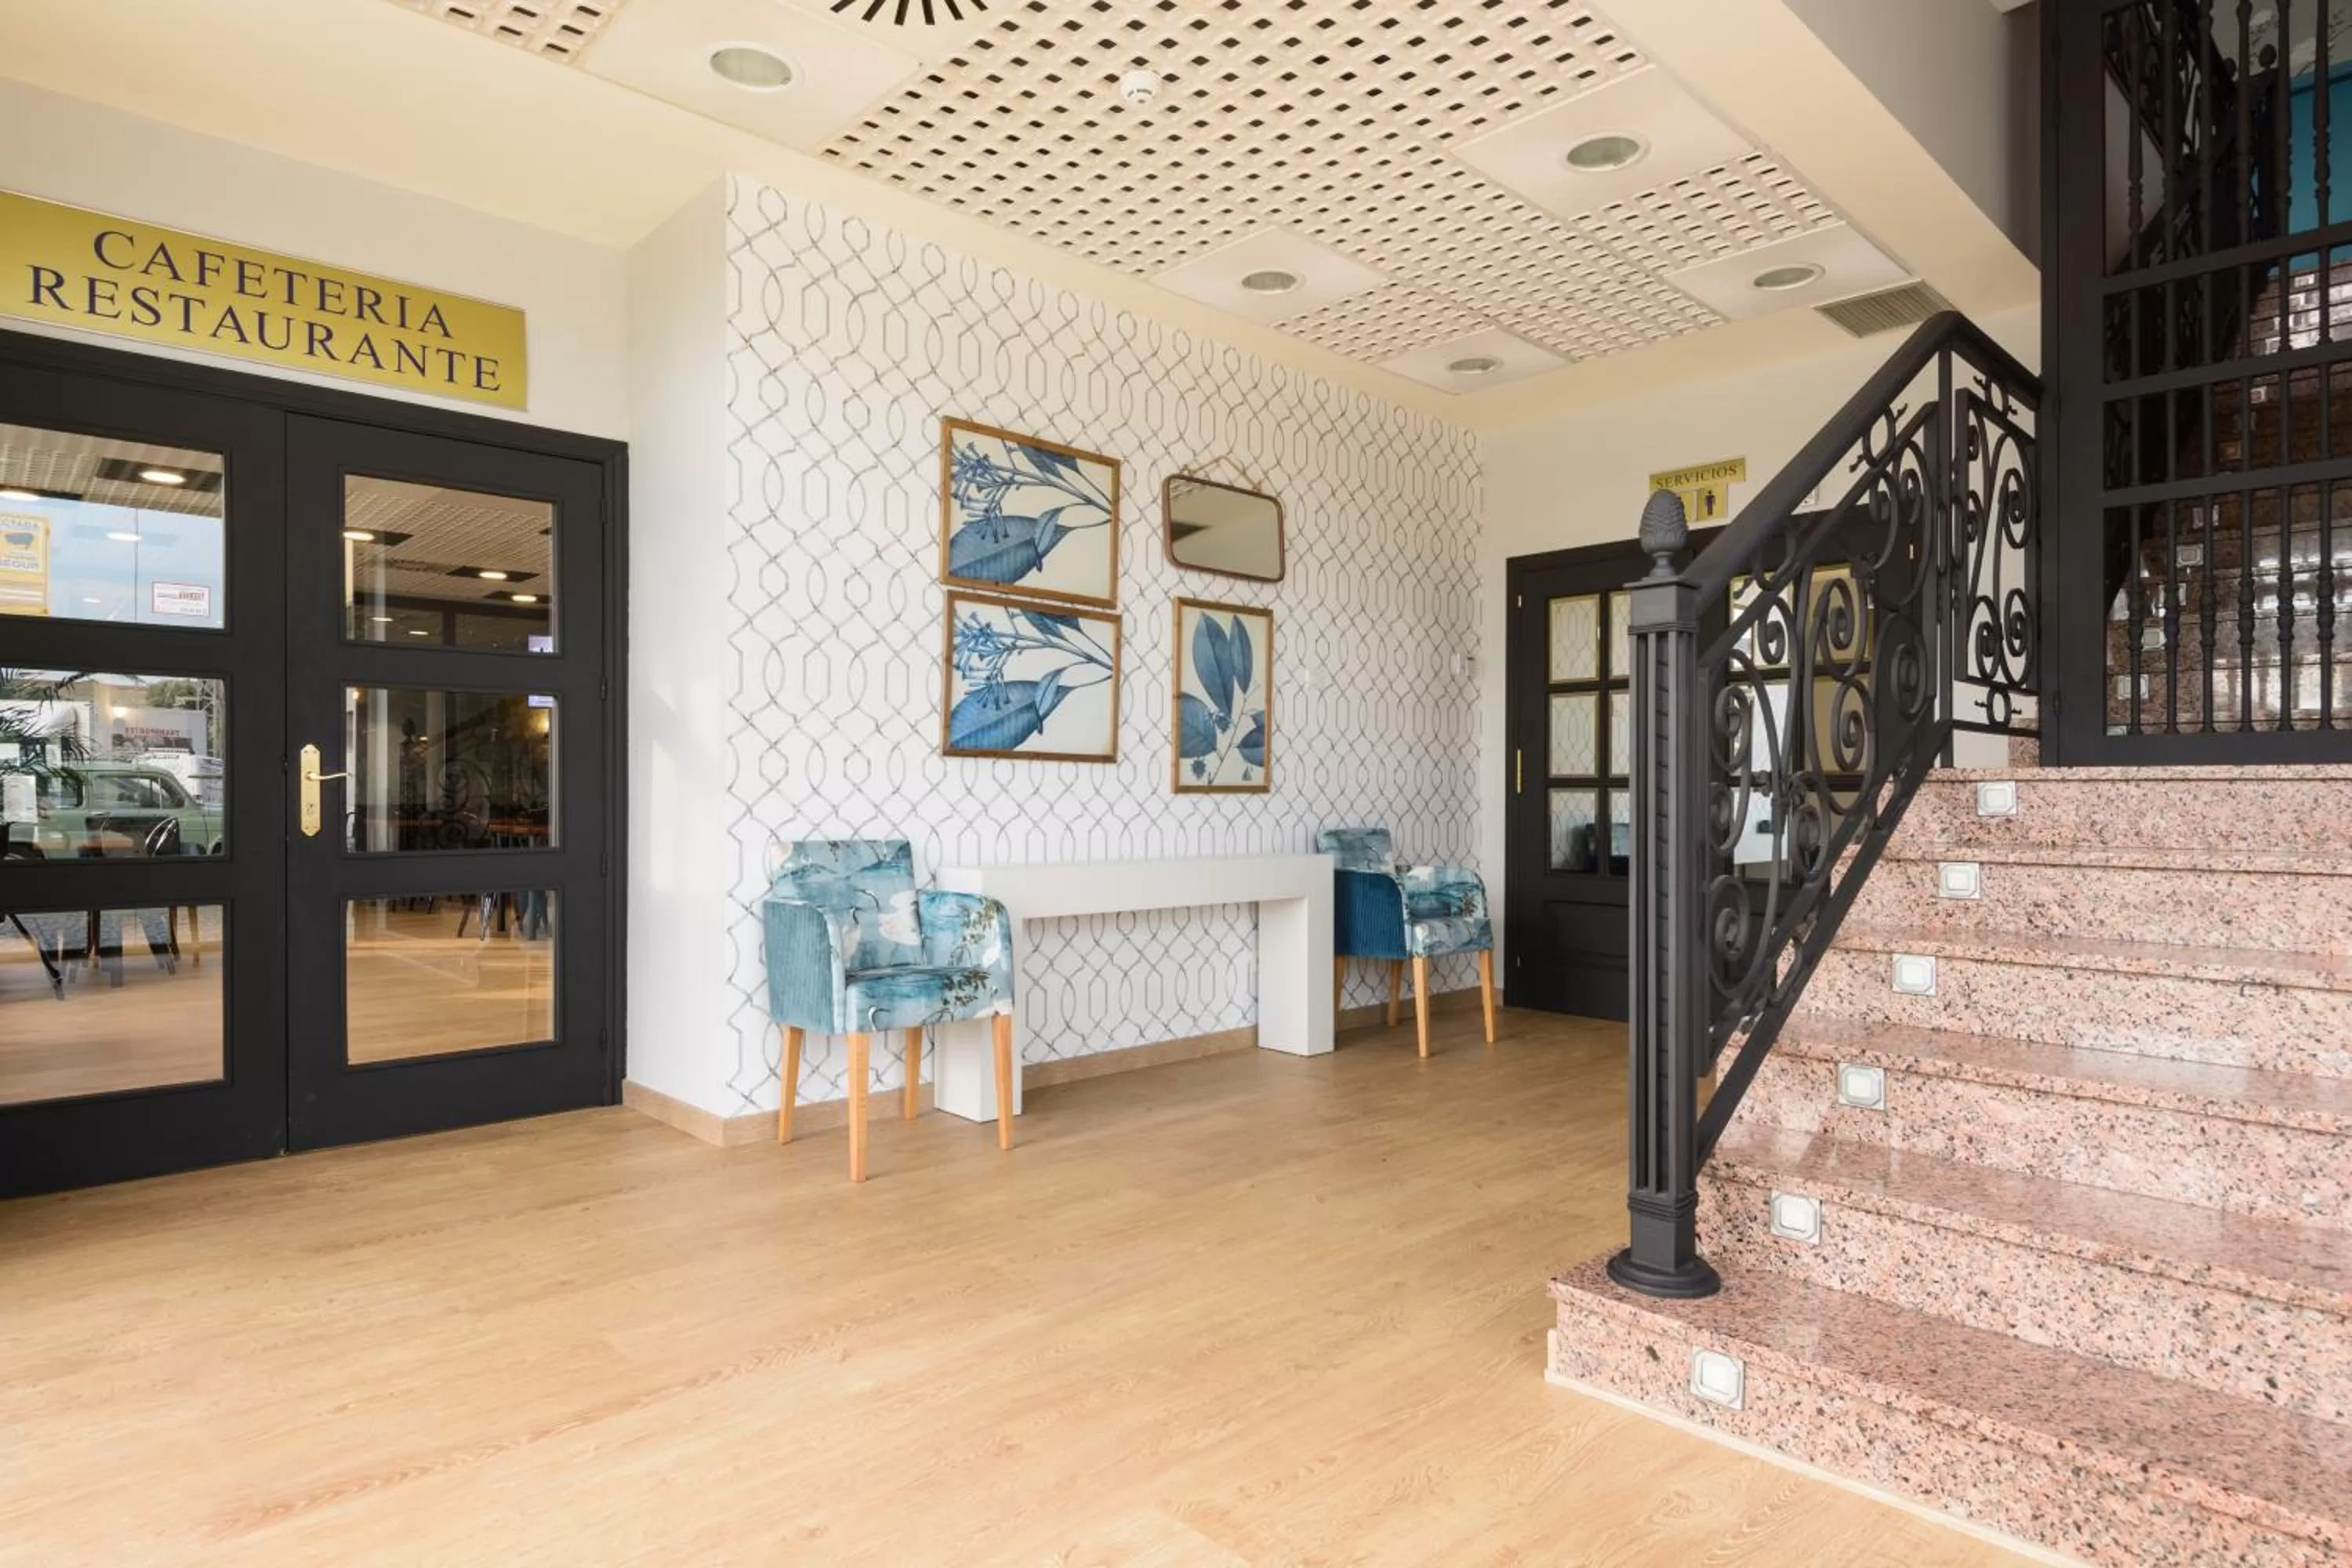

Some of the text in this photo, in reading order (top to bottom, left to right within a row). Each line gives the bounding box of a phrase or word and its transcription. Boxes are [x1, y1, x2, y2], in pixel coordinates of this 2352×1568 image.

[26, 264, 501, 392] RESTAURANTE
[93, 230, 452, 339] CAFETERIA
[1656, 463, 1737, 488] SERVICIOS
